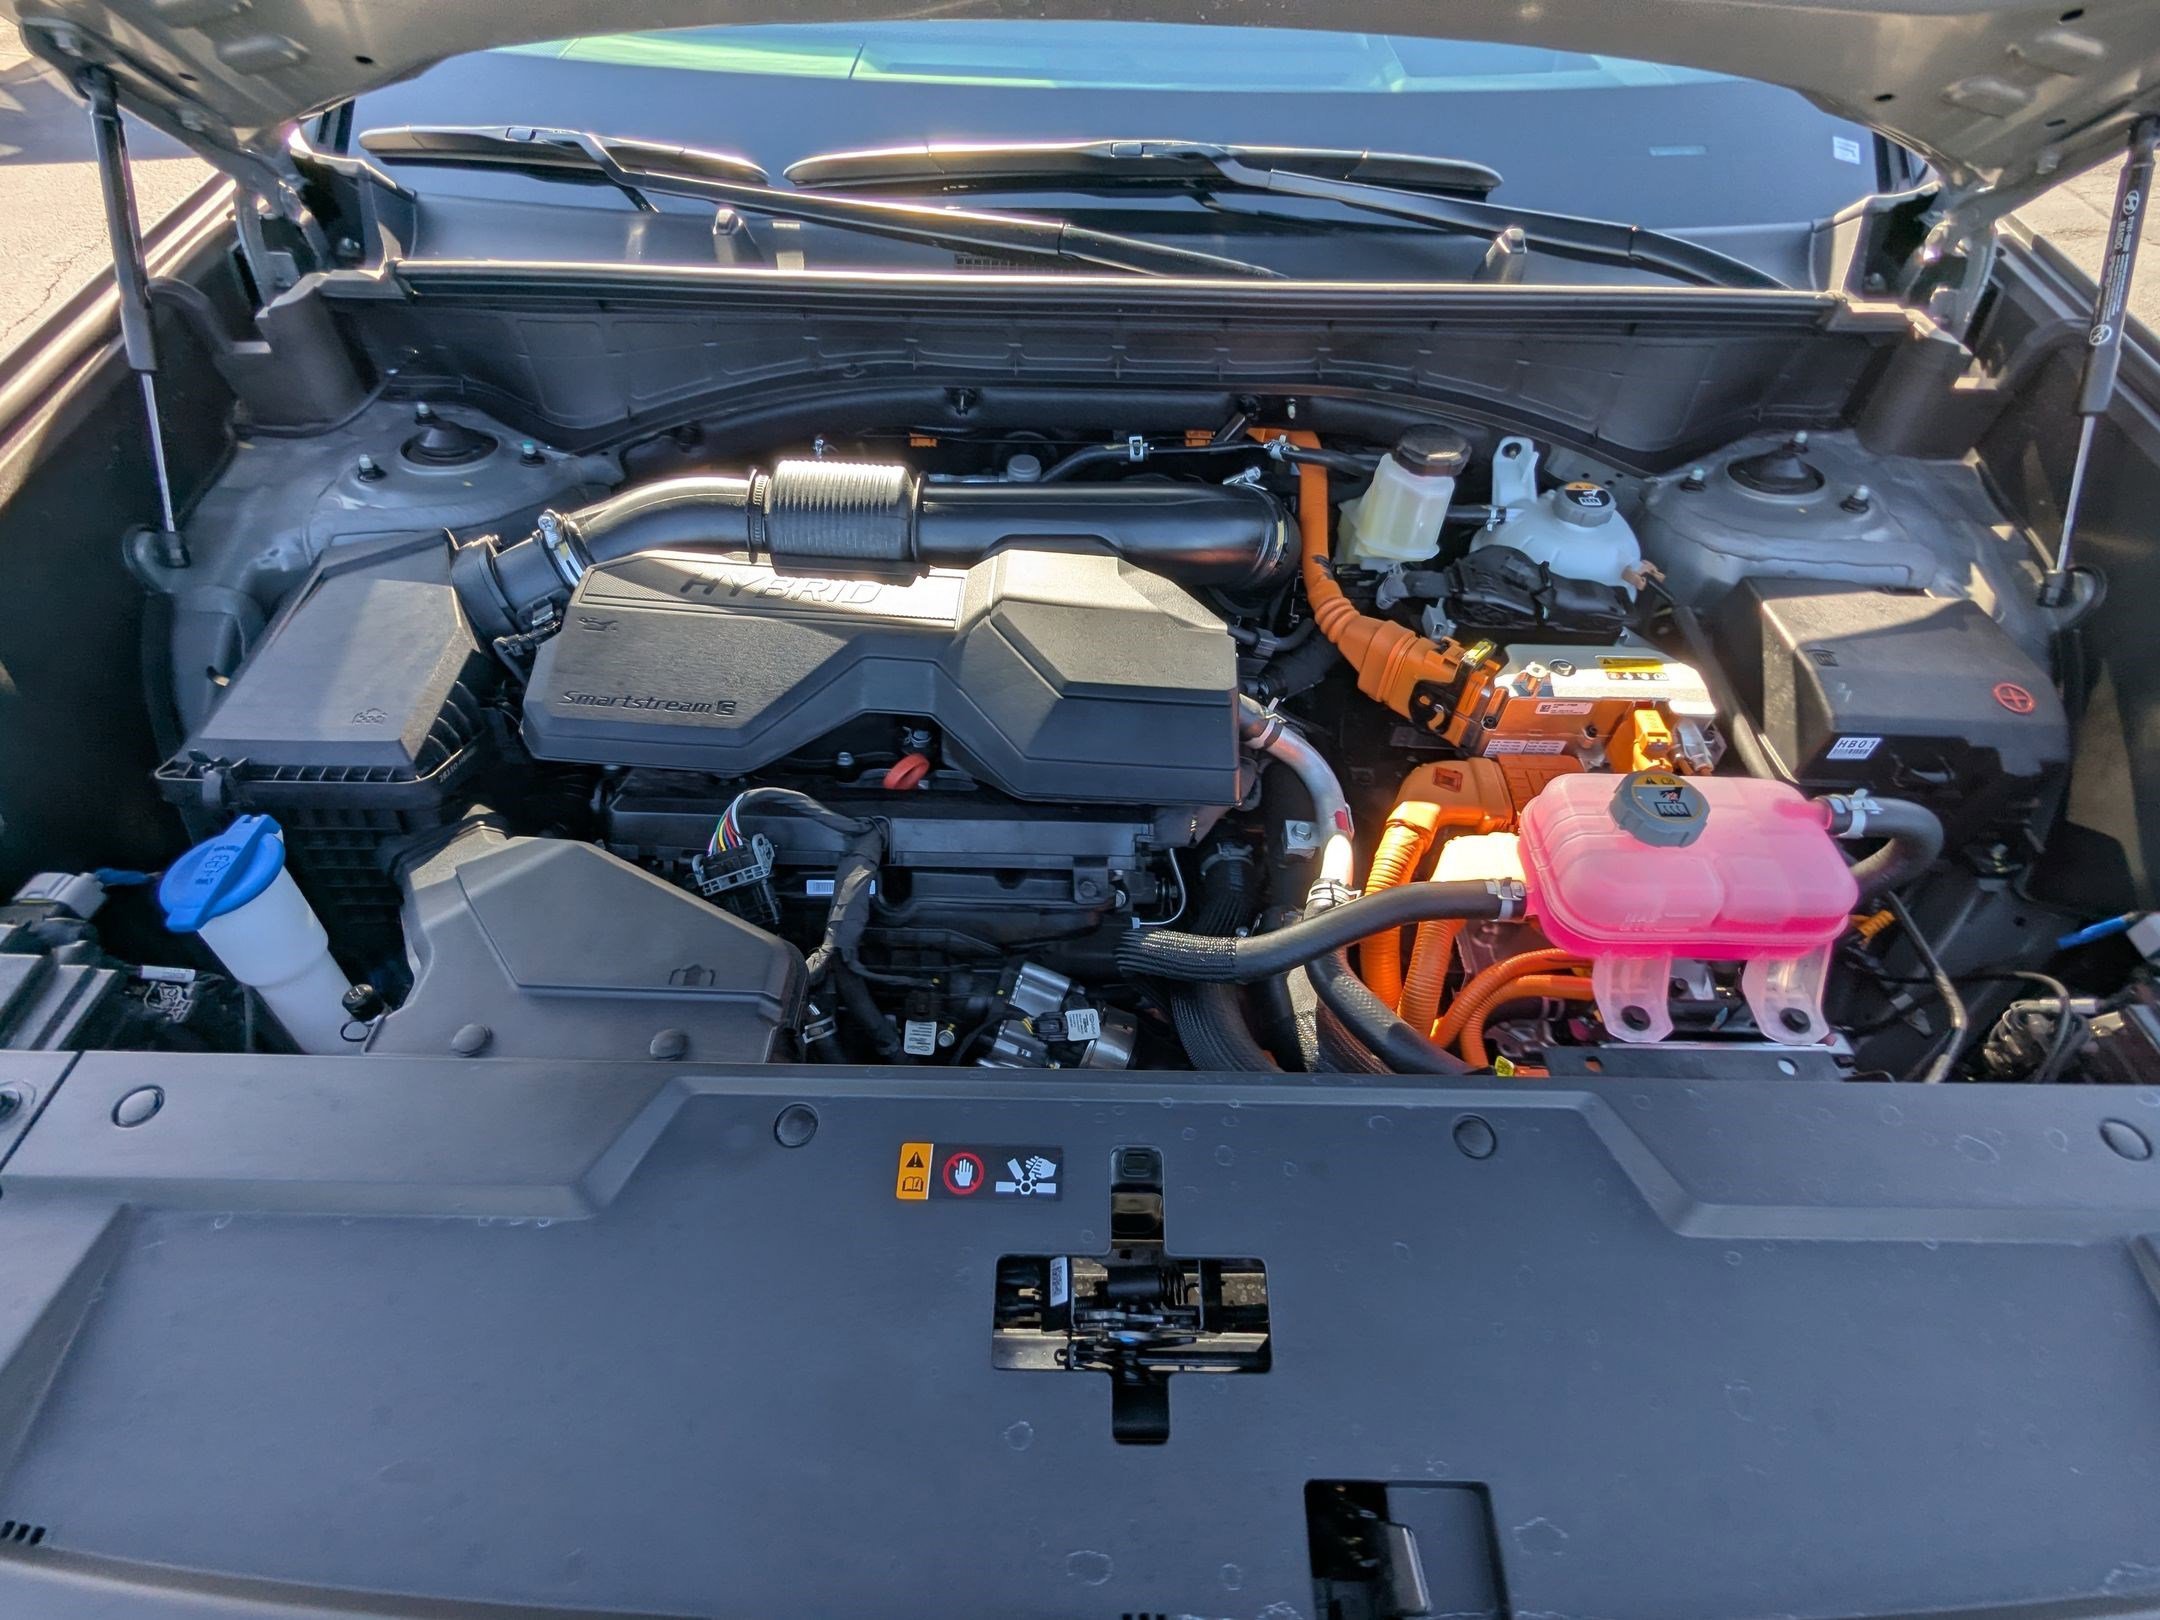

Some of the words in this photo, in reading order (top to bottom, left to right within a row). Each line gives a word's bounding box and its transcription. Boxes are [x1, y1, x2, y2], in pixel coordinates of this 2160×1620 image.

[680, 573, 883, 604] HYBRID
[558, 690, 712, 715] Smartstream
[1837, 740, 1877, 749] HB01
